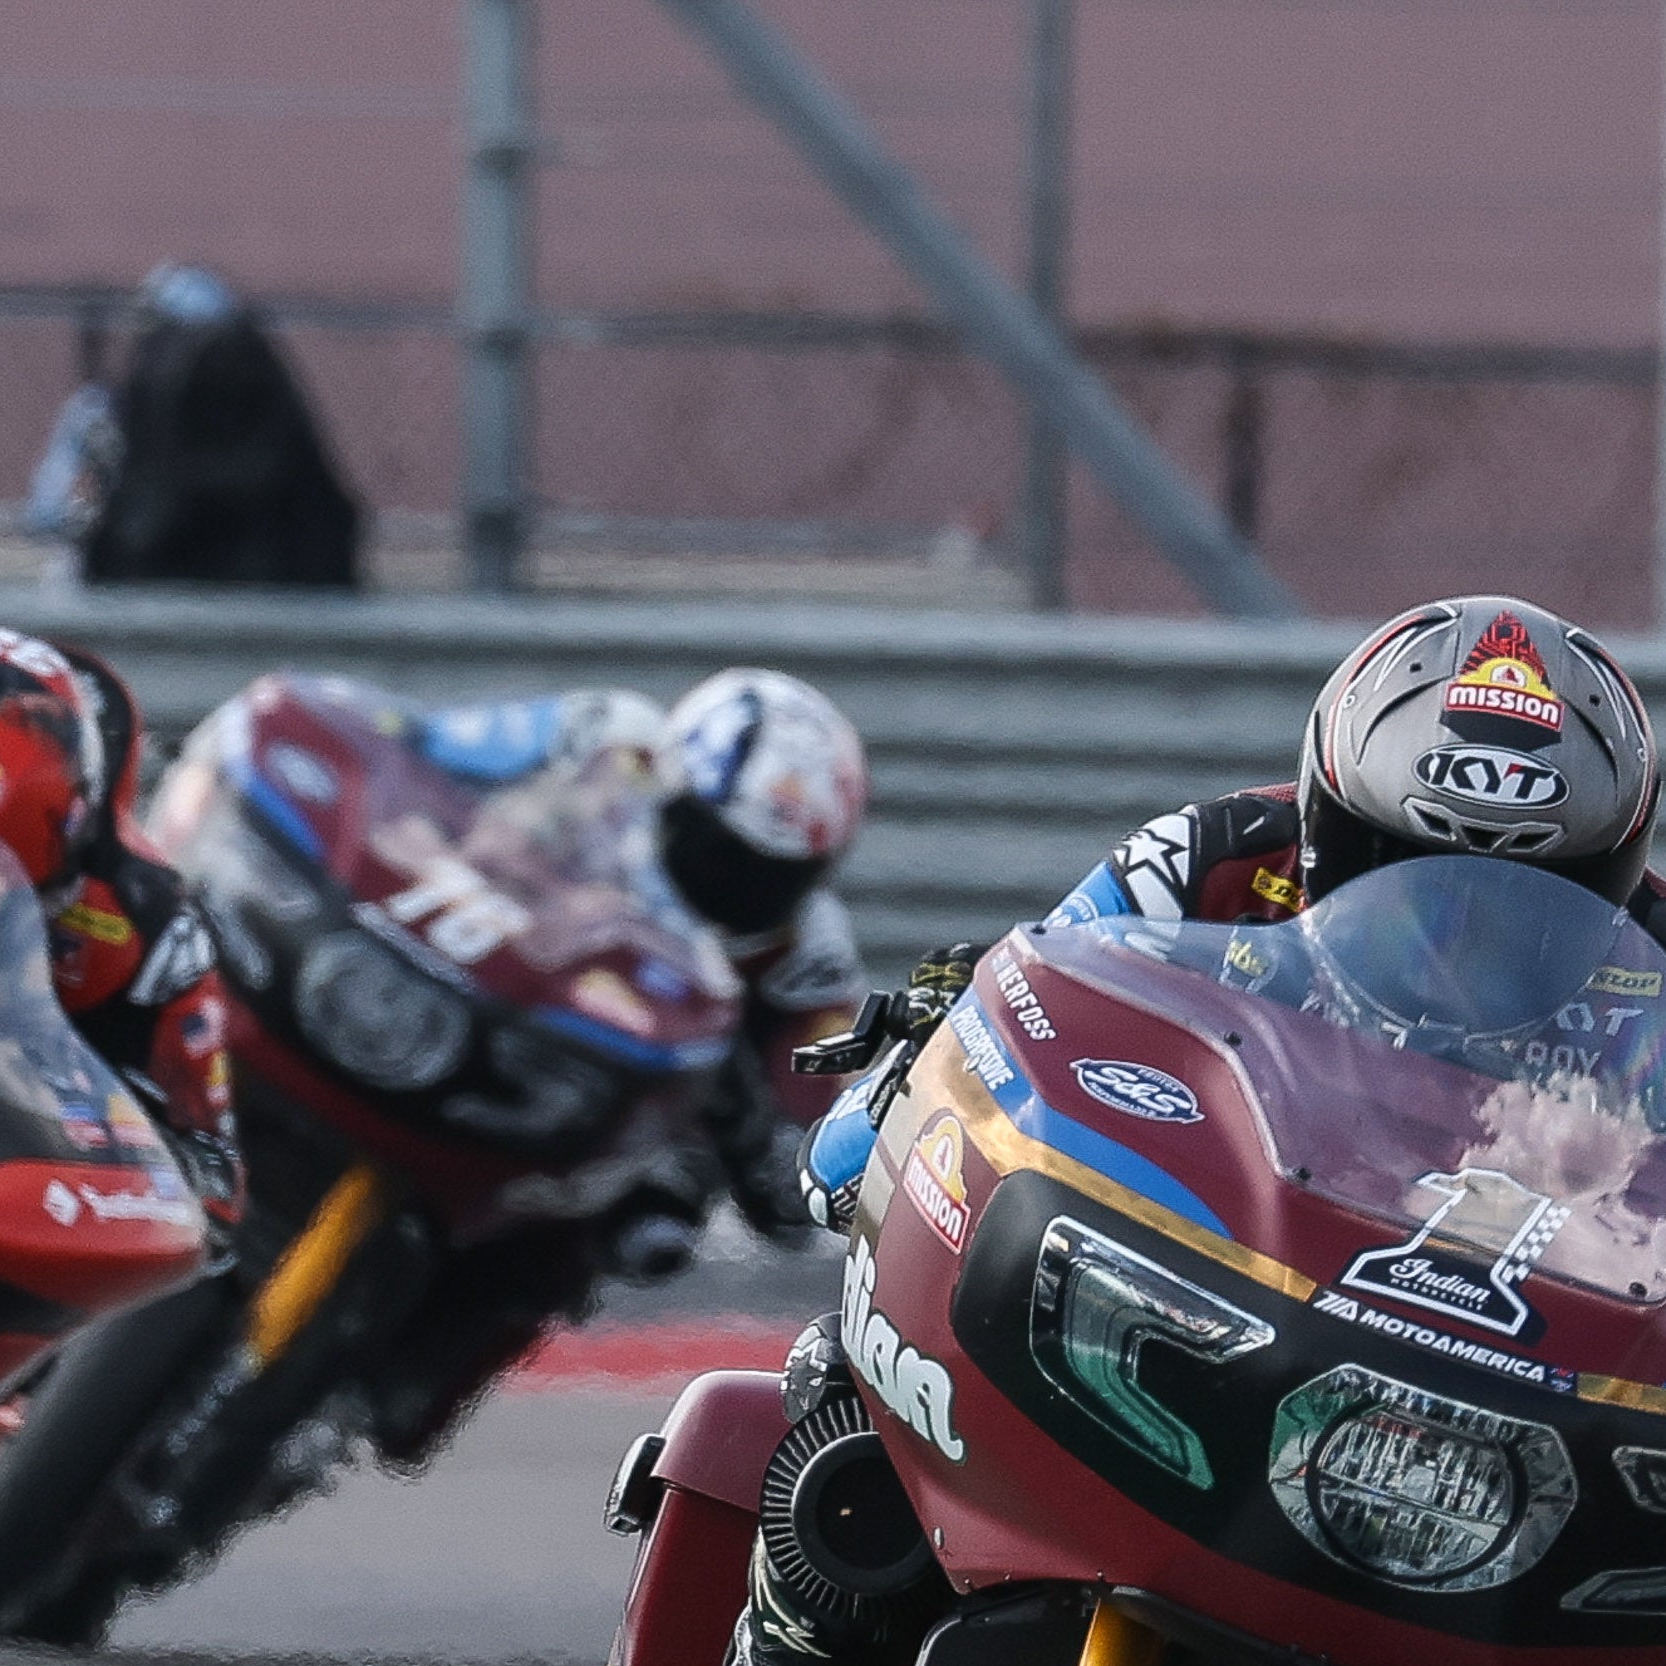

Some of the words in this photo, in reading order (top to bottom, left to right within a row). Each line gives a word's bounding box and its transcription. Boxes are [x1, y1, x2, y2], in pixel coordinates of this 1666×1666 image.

[1430, 750, 1555, 801] KYT
[1083, 1066, 1194, 1114] S&S
[1338, 1166, 1555, 1338] 1
[1388, 1257, 1493, 1304] Indian
[840, 1233, 965, 1462] dian
[1358, 1307, 1546, 1384] MOTOAMERICA
